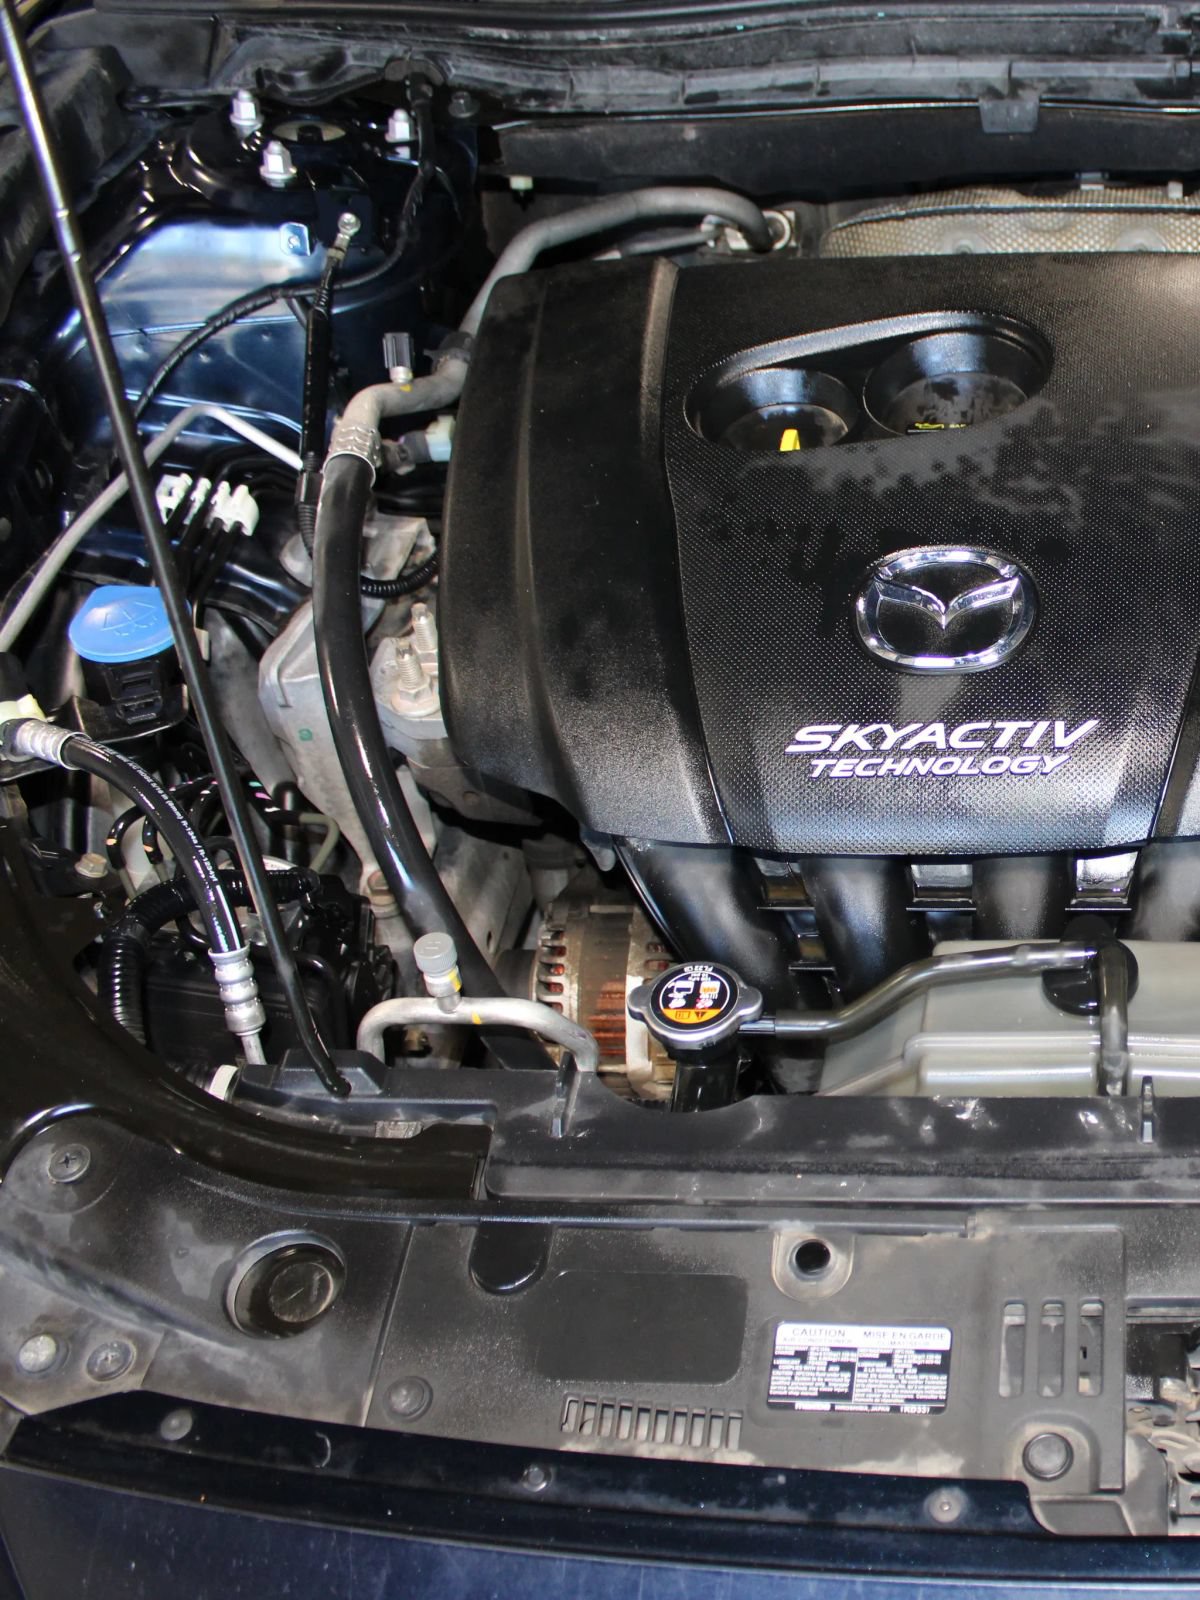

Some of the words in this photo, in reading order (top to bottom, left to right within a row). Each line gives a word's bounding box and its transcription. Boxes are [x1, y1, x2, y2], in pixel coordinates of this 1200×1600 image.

[785, 720, 1101, 754] SKYACTIV
[810, 754, 1072, 779] TECHNOLOGY
[180, 820, 198, 844] R-134a
[198, 849, 218, 882] R-1234yf
[792, 1328, 846, 1337] CAUTION
[892, 1331, 906, 1339] EN
[908, 1332, 946, 1340] GARDE
